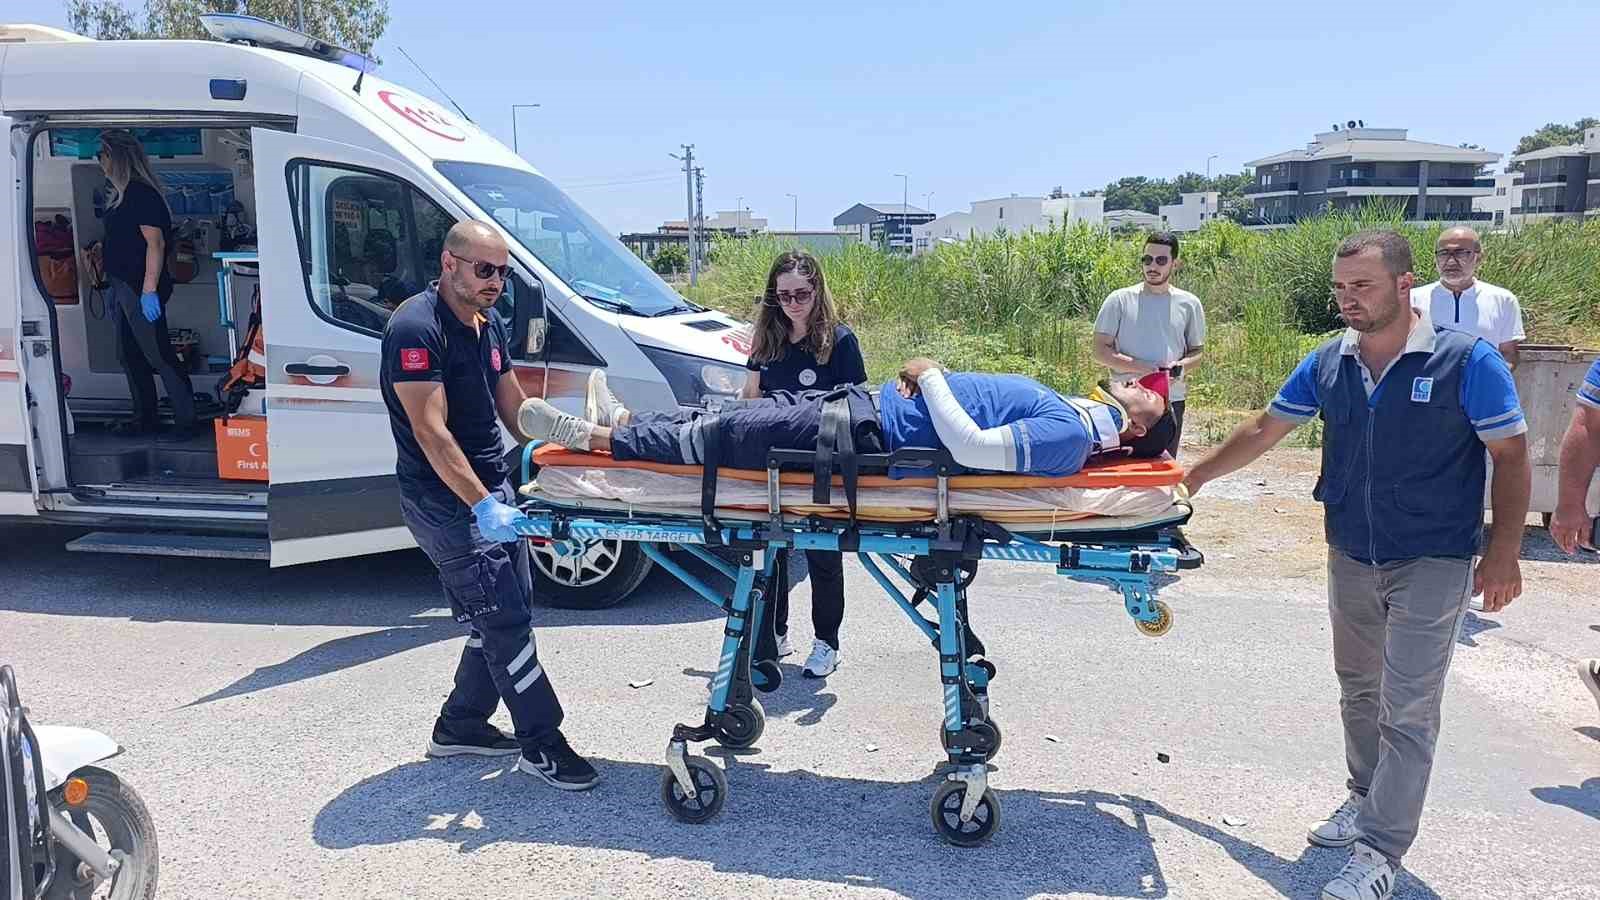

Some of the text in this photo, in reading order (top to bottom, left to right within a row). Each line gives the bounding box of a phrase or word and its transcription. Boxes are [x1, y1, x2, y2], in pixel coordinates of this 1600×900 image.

[237, 459, 259, 470] First
[607, 529, 693, 541] ES 125 TARGET
